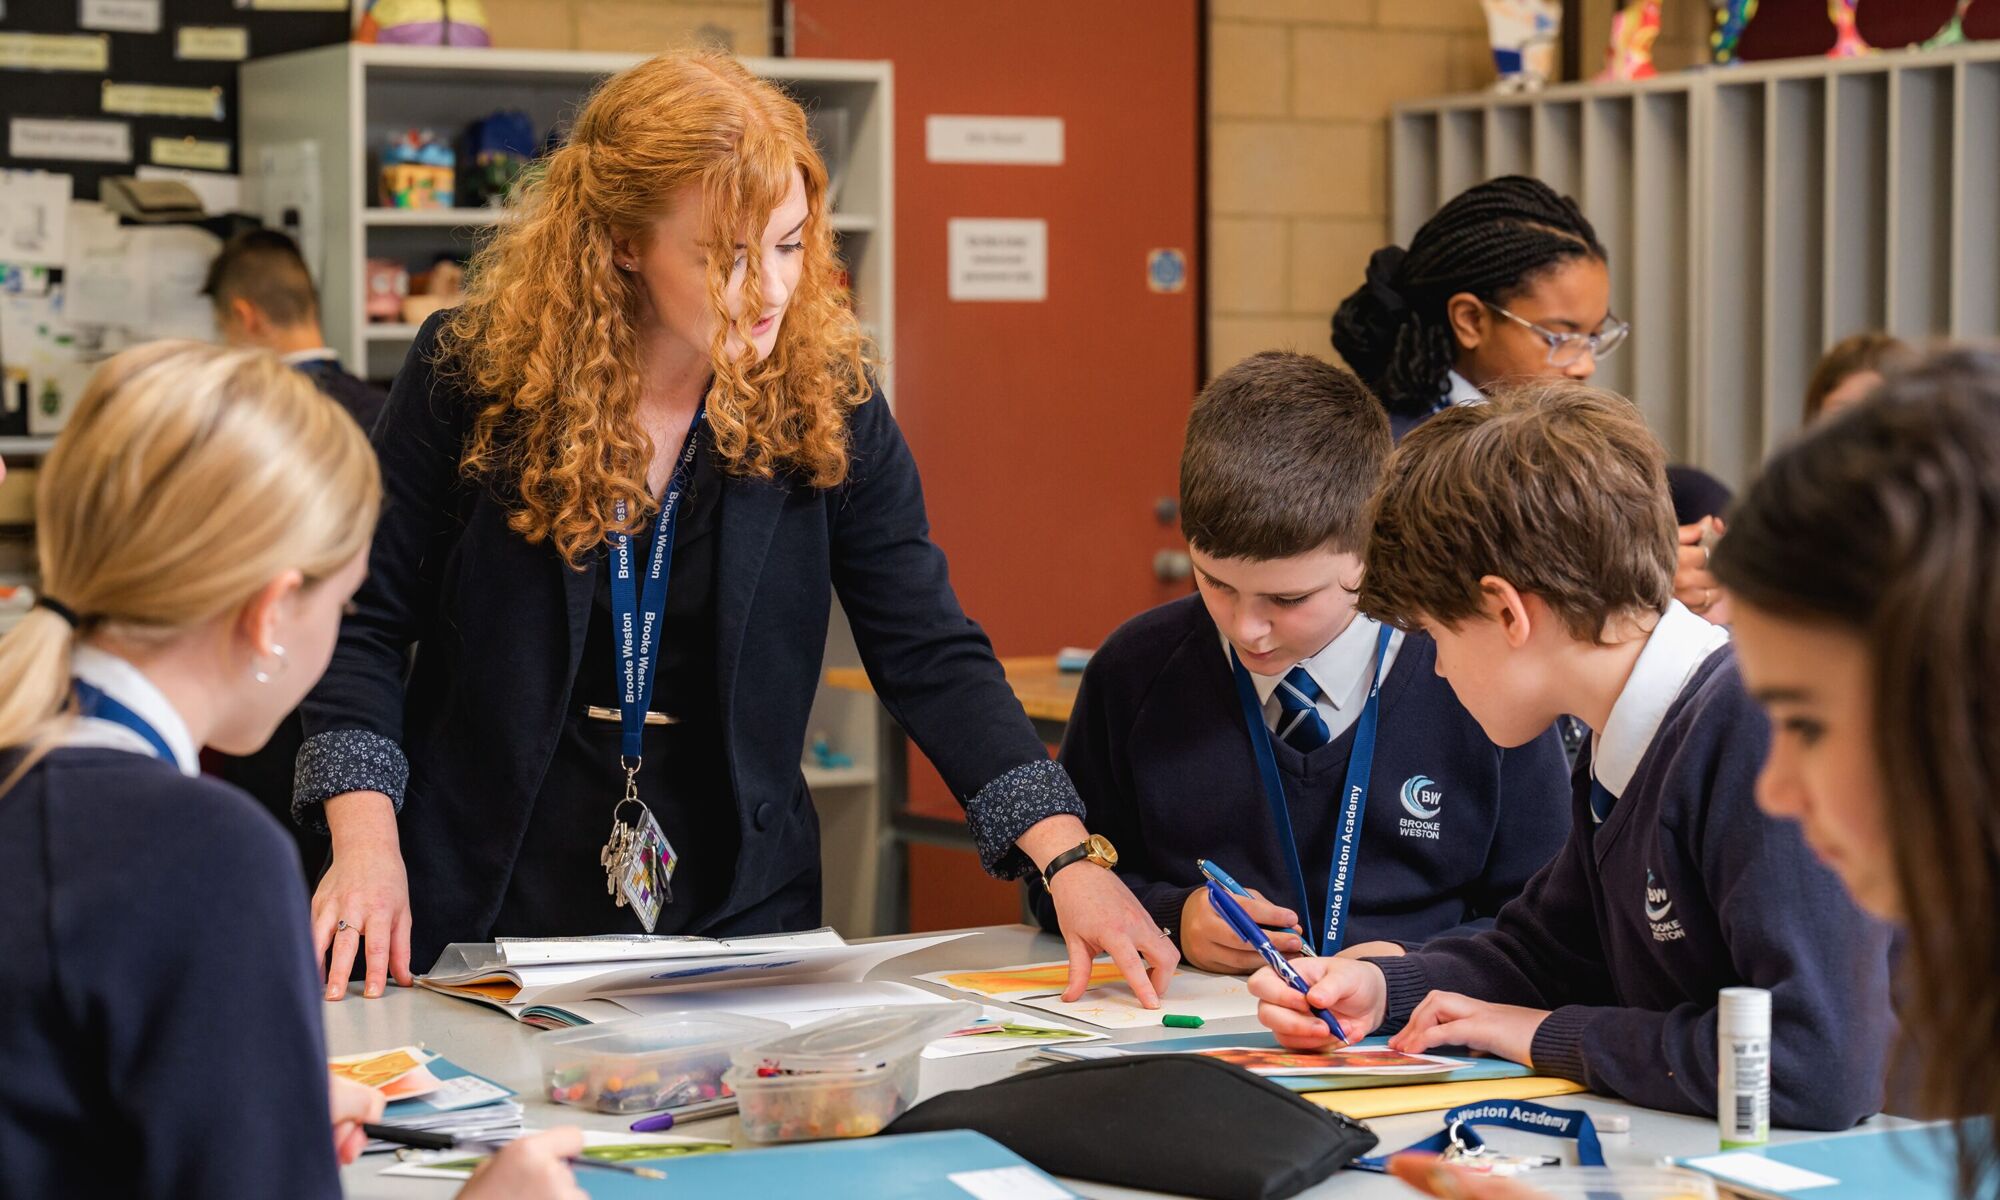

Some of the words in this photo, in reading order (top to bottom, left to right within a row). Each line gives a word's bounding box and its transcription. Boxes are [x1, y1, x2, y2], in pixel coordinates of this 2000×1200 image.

[660, 491, 679, 532] Brooke
[618, 535, 629, 579] Brooke
[651, 534, 668, 579] Weston
[622, 612, 633, 658] Weston
[640, 611, 656, 654] Brooke
[623, 660, 635, 703] Brooke
[1341, 785, 1362, 843] Academy
[1421, 790, 1442, 805] BW
[1399, 818, 1441, 831] BROOKE
[1399, 827, 1440, 840] WESTON
[1333, 845, 1351, 892] Weston
[1327, 894, 1343, 941] Brooke
[1457, 1105, 1508, 1123] Weston
[1509, 1106, 1571, 1132] Academy
